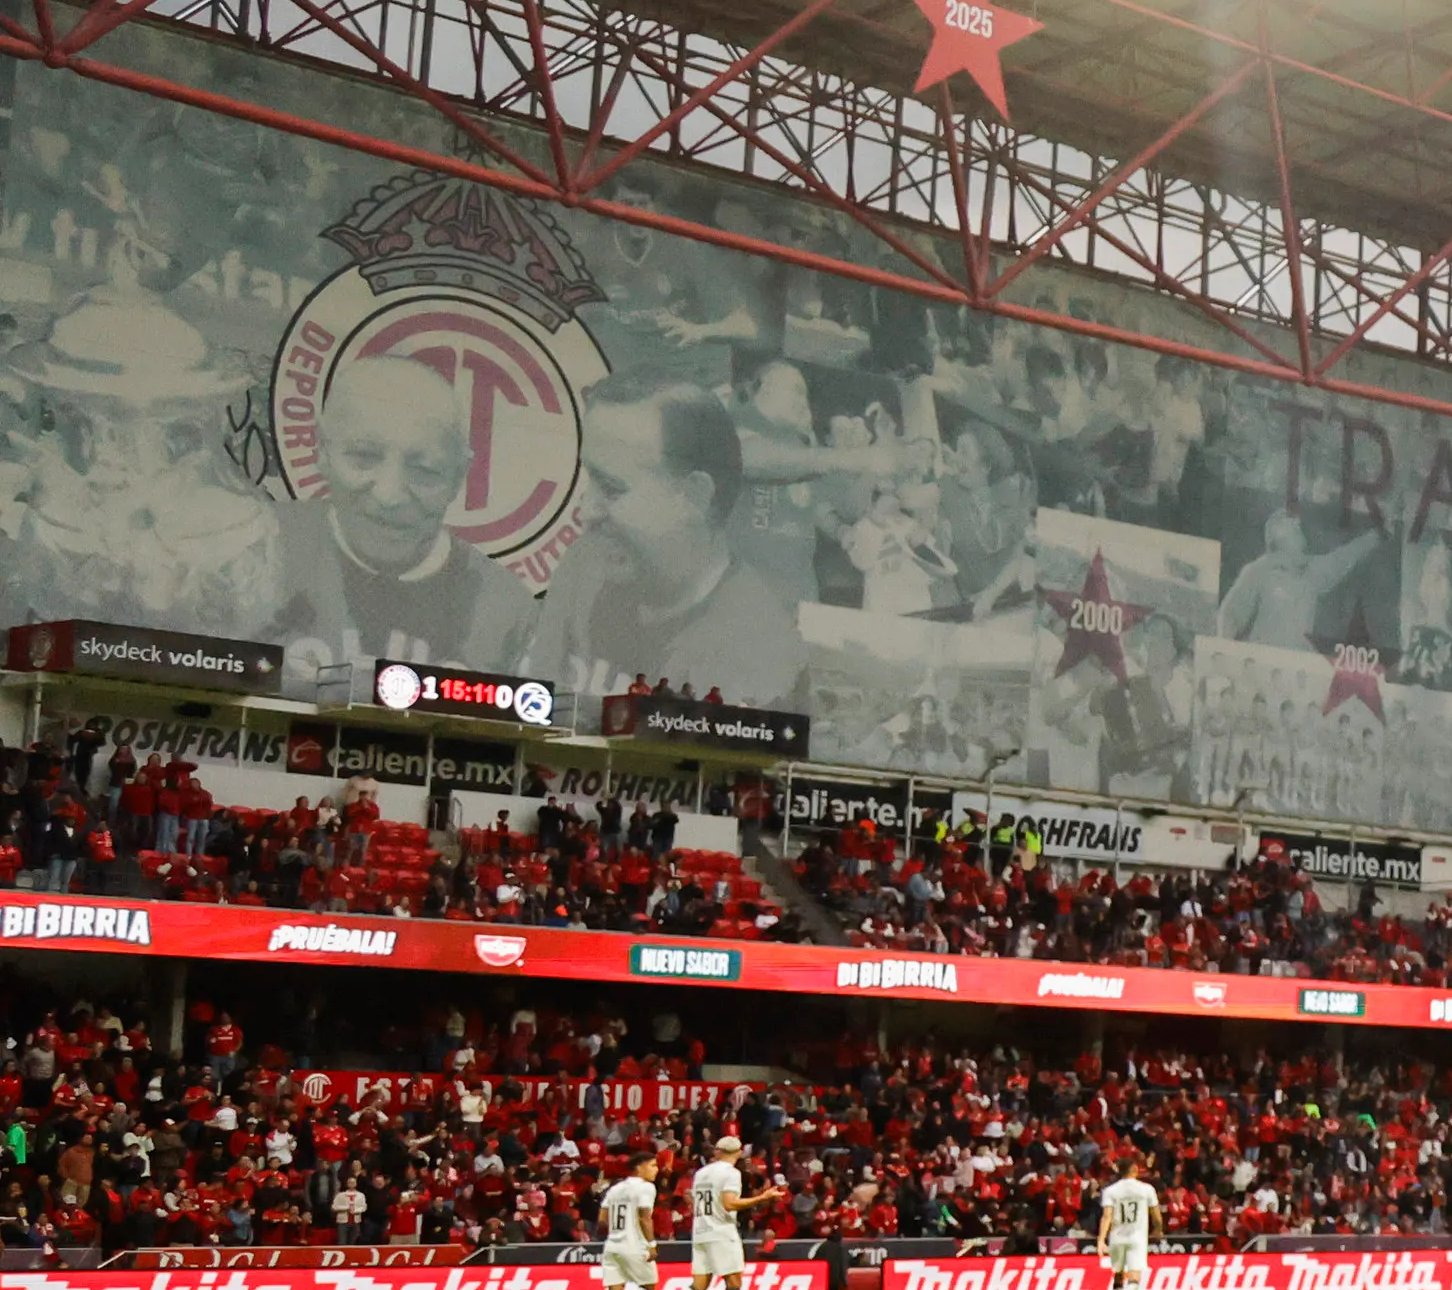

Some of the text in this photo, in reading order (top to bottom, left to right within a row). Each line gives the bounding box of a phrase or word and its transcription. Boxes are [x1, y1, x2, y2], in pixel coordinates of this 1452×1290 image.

[282, 320, 336, 499] DEPORTI
[505, 507, 582, 584] FUTB
[1071, 599, 1122, 635] 2000
[81, 638, 245, 673] skydeck volaris
[1333, 643, 1380, 676] 2002
[421, 676, 513, 708] 1 15:11 0
[648, 711, 775, 741] skydeck volaris
[327, 745, 512, 785] caliente.mx
[1002, 813, 1141, 852] OSHFRANS
[612, 1204, 627, 1230] 16
[1120, 1201, 1138, 1225] 13
